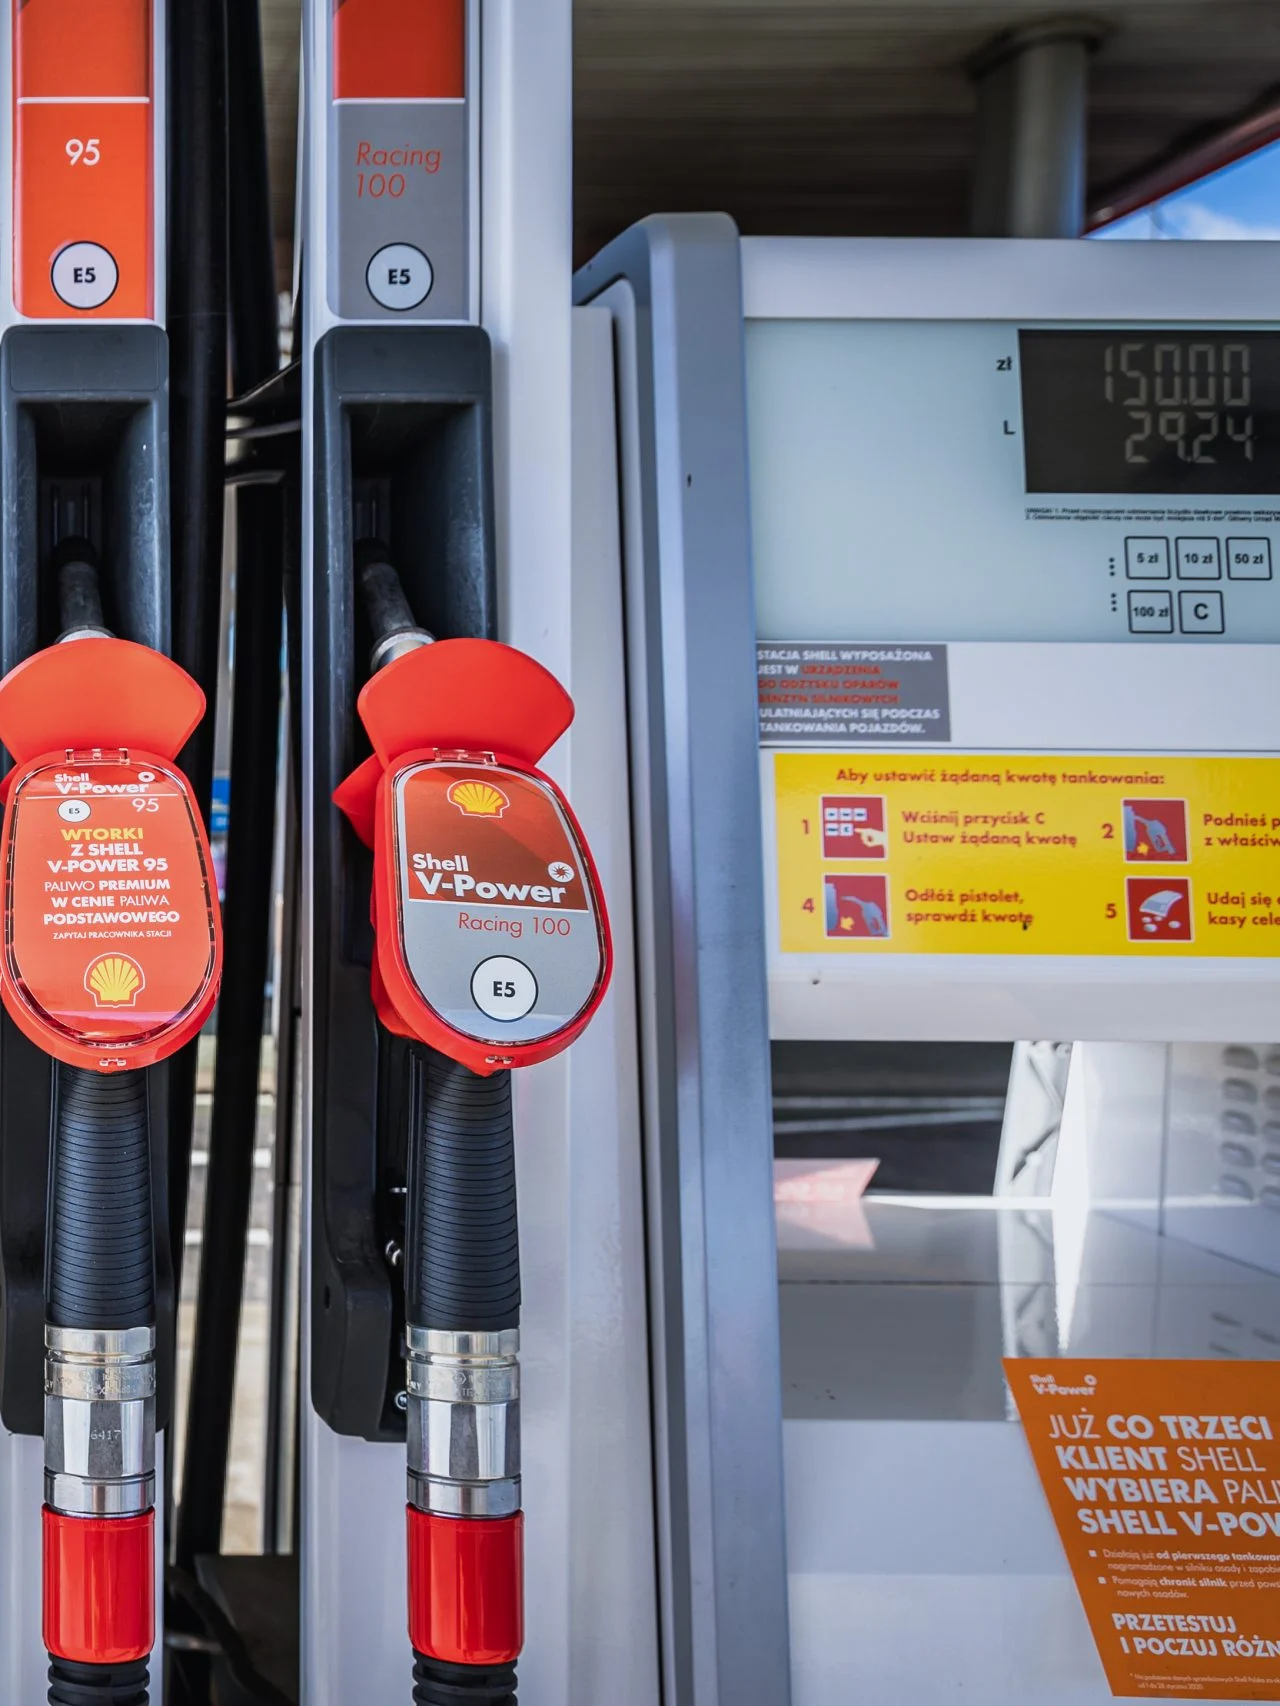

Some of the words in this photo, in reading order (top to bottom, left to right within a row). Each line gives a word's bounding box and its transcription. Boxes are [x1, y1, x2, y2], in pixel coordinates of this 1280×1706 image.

[65, 139, 100, 166] 95
[357, 141, 441, 174] Racing
[357, 174, 405, 198] 100
[73, 267, 95, 284] E5
[388, 269, 410, 286] E5
[996, 356, 1012, 371] zł
[1105, 343, 1251, 407] 150.00
[1004, 420, 1016, 436] L
[1137, 553, 1145, 563] 5
[1148, 553, 1158, 563] zł
[1184, 553, 1199, 564] 10
[1202, 553, 1213, 564] zł
[1235, 554, 1249, 564] 50
[1253, 554, 1263, 564] zł
[1133, 606, 1155, 617] 100
[1193, 603, 1209, 620] C
[758, 650, 800, 660] STACJA
[802, 650, 838, 660] SHELL
[758, 664, 782, 675] JEST
[784, 664, 799, 675] W
[881, 708, 941, 719] PODCZAS
[760, 722, 847, 732] TANKOWANIA
[54, 773, 89, 783] Shell
[836, 769, 869, 784] Aby
[873, 769, 936, 782] ustawić
[941, 769, 1001, 785] żądaną
[1005, 770, 1056, 785] kwotę
[1062, 771, 1164, 784] tankowania:
[55, 781, 149, 795] V-Power
[132, 798, 159, 812] 95
[802, 819, 810, 834] 1
[902, 811, 959, 827] Wciśnij
[963, 812, 1029, 827] przycisk
[1035, 813, 1045, 824] C
[1203, 813, 1267, 826] Podnieś
[61, 828, 144, 840] WTORKI
[903, 831, 954, 843] Ustaw
[960, 830, 1021, 846] żądaną
[1025, 832, 1077, 847] kwotę
[1102, 823, 1114, 839] 2
[1205, 837, 1213, 846] z
[70, 844, 84, 856] Z
[88, 843, 143, 856] SHELL
[47, 860, 139, 873] V-POWER
[144, 858, 168, 871] 95
[412, 853, 469, 872] Shell
[45, 881, 94, 892] PALIWO
[99, 879, 170, 891] PREMIUM
[414, 871, 566, 904] V-Power
[51, 897, 69, 908] W
[72, 896, 114, 908] CENIE
[120, 895, 169, 906] PALIWA
[905, 889, 953, 902] Odłóż
[960, 889, 1023, 904] pistolet,
[1207, 892, 1245, 908] Udaj
[1251, 893, 1271, 907] się
[802, 899, 814, 913] 4
[1105, 904, 1116, 918] 5
[44, 911, 180, 925] PODSTAWOWEGO
[907, 909, 976, 924] sprawdź
[982, 910, 1033, 924] kwotę
[1208, 912, 1246, 928] kasy
[458, 912, 522, 938] Racing
[532, 917, 570, 936] 100
[53, 932, 87, 940] ZAPYTAJ
[88, 931, 145, 939] PRACOWNIKA
[146, 930, 172, 938] STACJI
[493, 981, 516, 998] E5
[1032, 1384, 1096, 1396] V-Power
[1049, 1407, 1100, 1439] JUŻ
[1106, 1415, 1154, 1439] CO
[1160, 1415, 1273, 1440] TRZECI
[1055, 1446, 1168, 1470] KLIENT
[1177, 1447, 1266, 1472] SHELL
[1063, 1477, 1219, 1503] WYBIERA
[1223, 1479, 1280, 1504] PALI
[1077, 1509, 1177, 1535] SHELL
[1156, 1551, 1170, 1560] od
[1172, 1552, 1230, 1562] pierwszego
[1231, 1552, 1280, 1561] tankowa
[1111, 1613, 1237, 1633] PRZETESTUJ
[1120, 1636, 1130, 1654] I
[1132, 1637, 1218, 1656] POCZUJ
